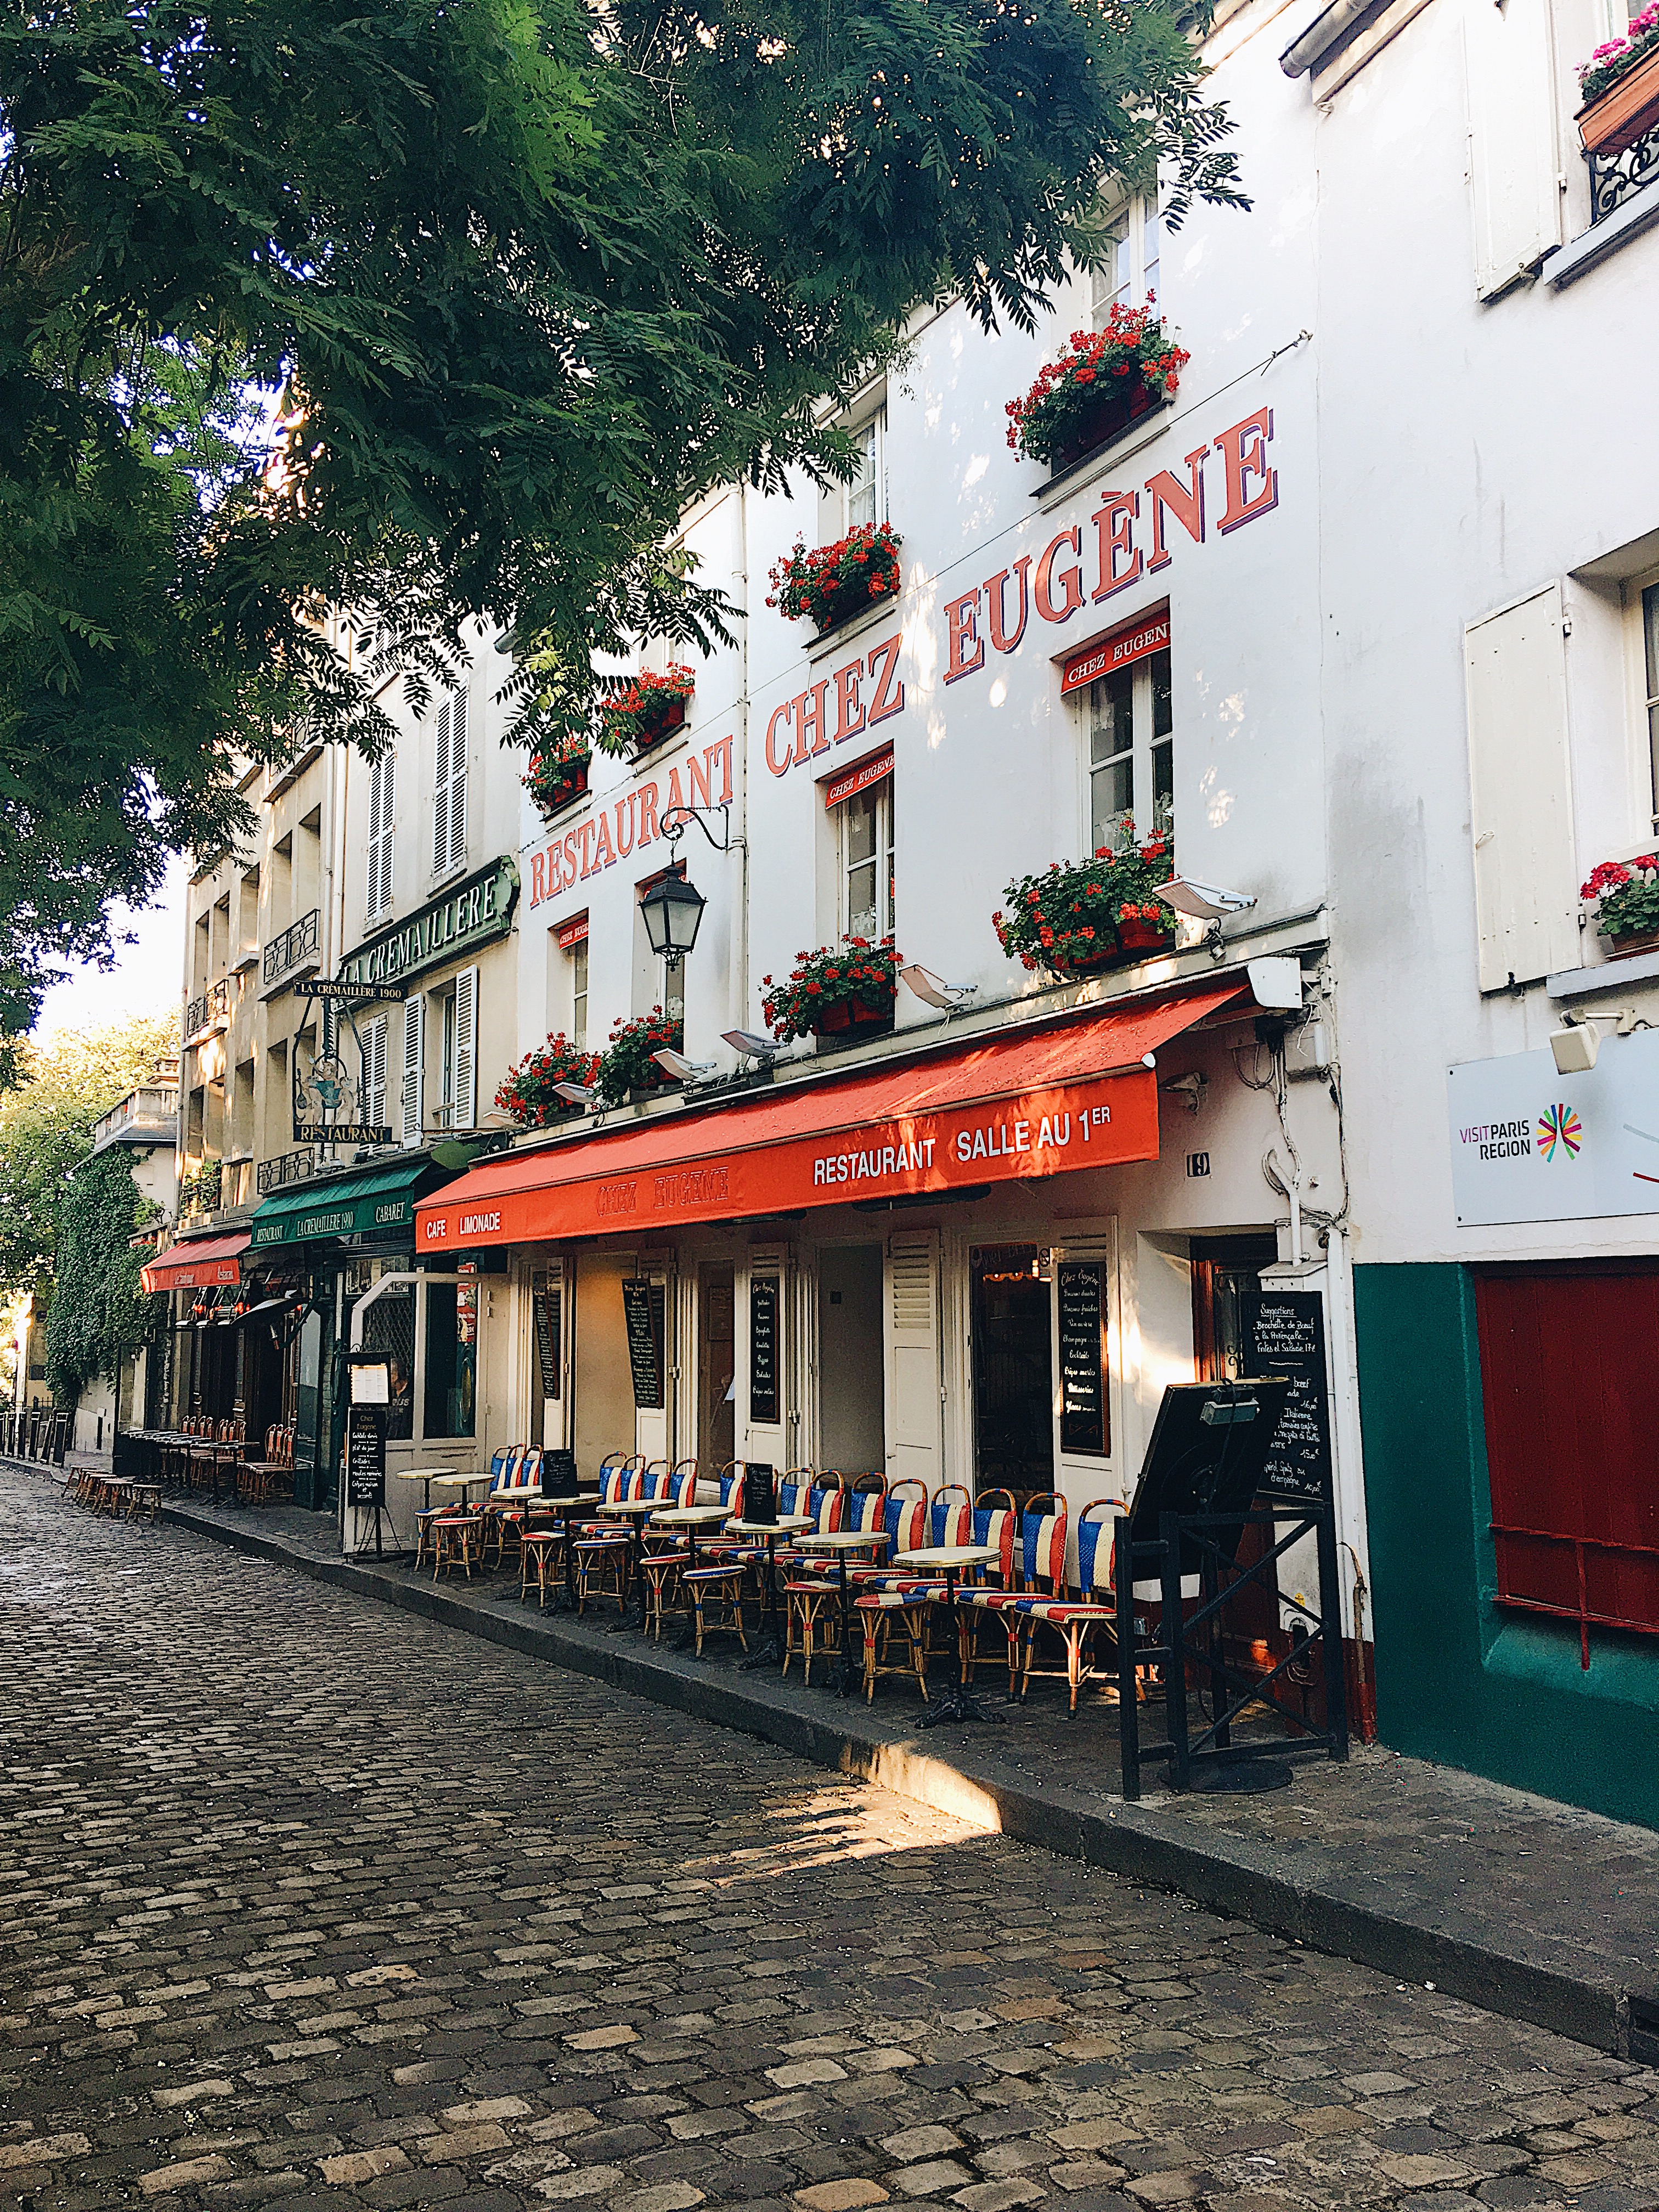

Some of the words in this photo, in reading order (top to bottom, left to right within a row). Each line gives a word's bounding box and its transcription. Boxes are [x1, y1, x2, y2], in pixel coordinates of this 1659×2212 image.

[529, 734, 735, 910] RESTAURANT
[765, 633, 905, 779] CHEZ
[943, 407, 1279, 686] EUGÈNE
[1068, 653, 1105, 682] CHEZ
[1113, 622, 1171, 662] EUGEN
[830, 777, 855, 799] CHEZ
[366, 875, 496, 984] CREMAILLERE
[560, 930, 573, 945] CHEZ
[301, 984, 313, 993] LA
[317, 983, 376, 997] CRÉMAILLÈRE
[380, 988, 402, 998] 1900
[814, 1138, 936, 1185] RESTAURANT
[957, 1120, 1030, 1162] SALLE
[1037, 1113, 1070, 1149] AU
[1480, 1139, 1531, 1160] REGION
[1189, 1153, 1207, 1176] 19
[597, 1181, 637, 1217] CHEZ
[653, 1166, 729, 1209] EUGENE
[256, 1225, 283, 1242] RESTAURANT
[304, 1214, 341, 1235] CREMAILLERE
[341, 1211, 354, 1230] 1900
[375, 1201, 406, 1223] CABARET
[427, 1219, 446, 1239] CAFE
[460, 1211, 500, 1234] LIMONADE
[1062, 1272, 1076, 1286] Chez
[1260, 1302, 1295, 1321] Suggestions
[1262, 1330, 1269, 1340] la
[1287, 1320, 1295, 1329] de
